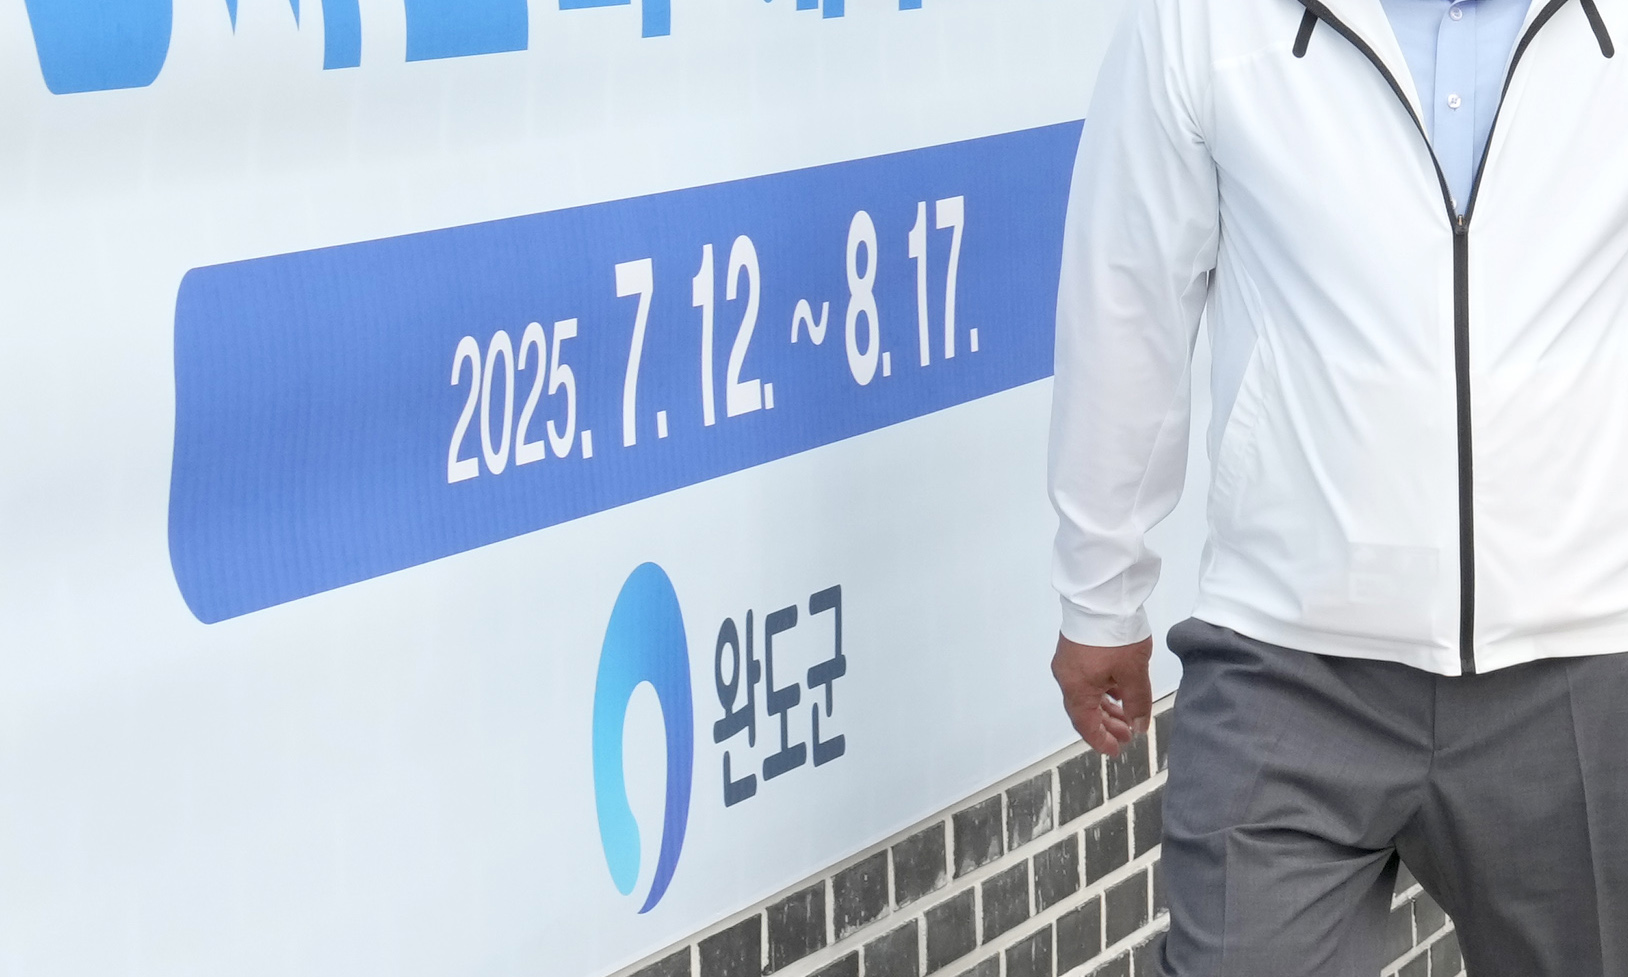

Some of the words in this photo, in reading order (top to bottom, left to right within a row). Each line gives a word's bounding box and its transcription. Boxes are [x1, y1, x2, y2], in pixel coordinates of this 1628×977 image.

[447, 318, 593, 484] 2025.
[615, 257, 668, 447] 7.
[693, 234, 774, 427] 12.
[846, 210, 891, 386] 8.
[909, 195, 979, 367] 17.
[714, 585, 847, 808] 완도군
